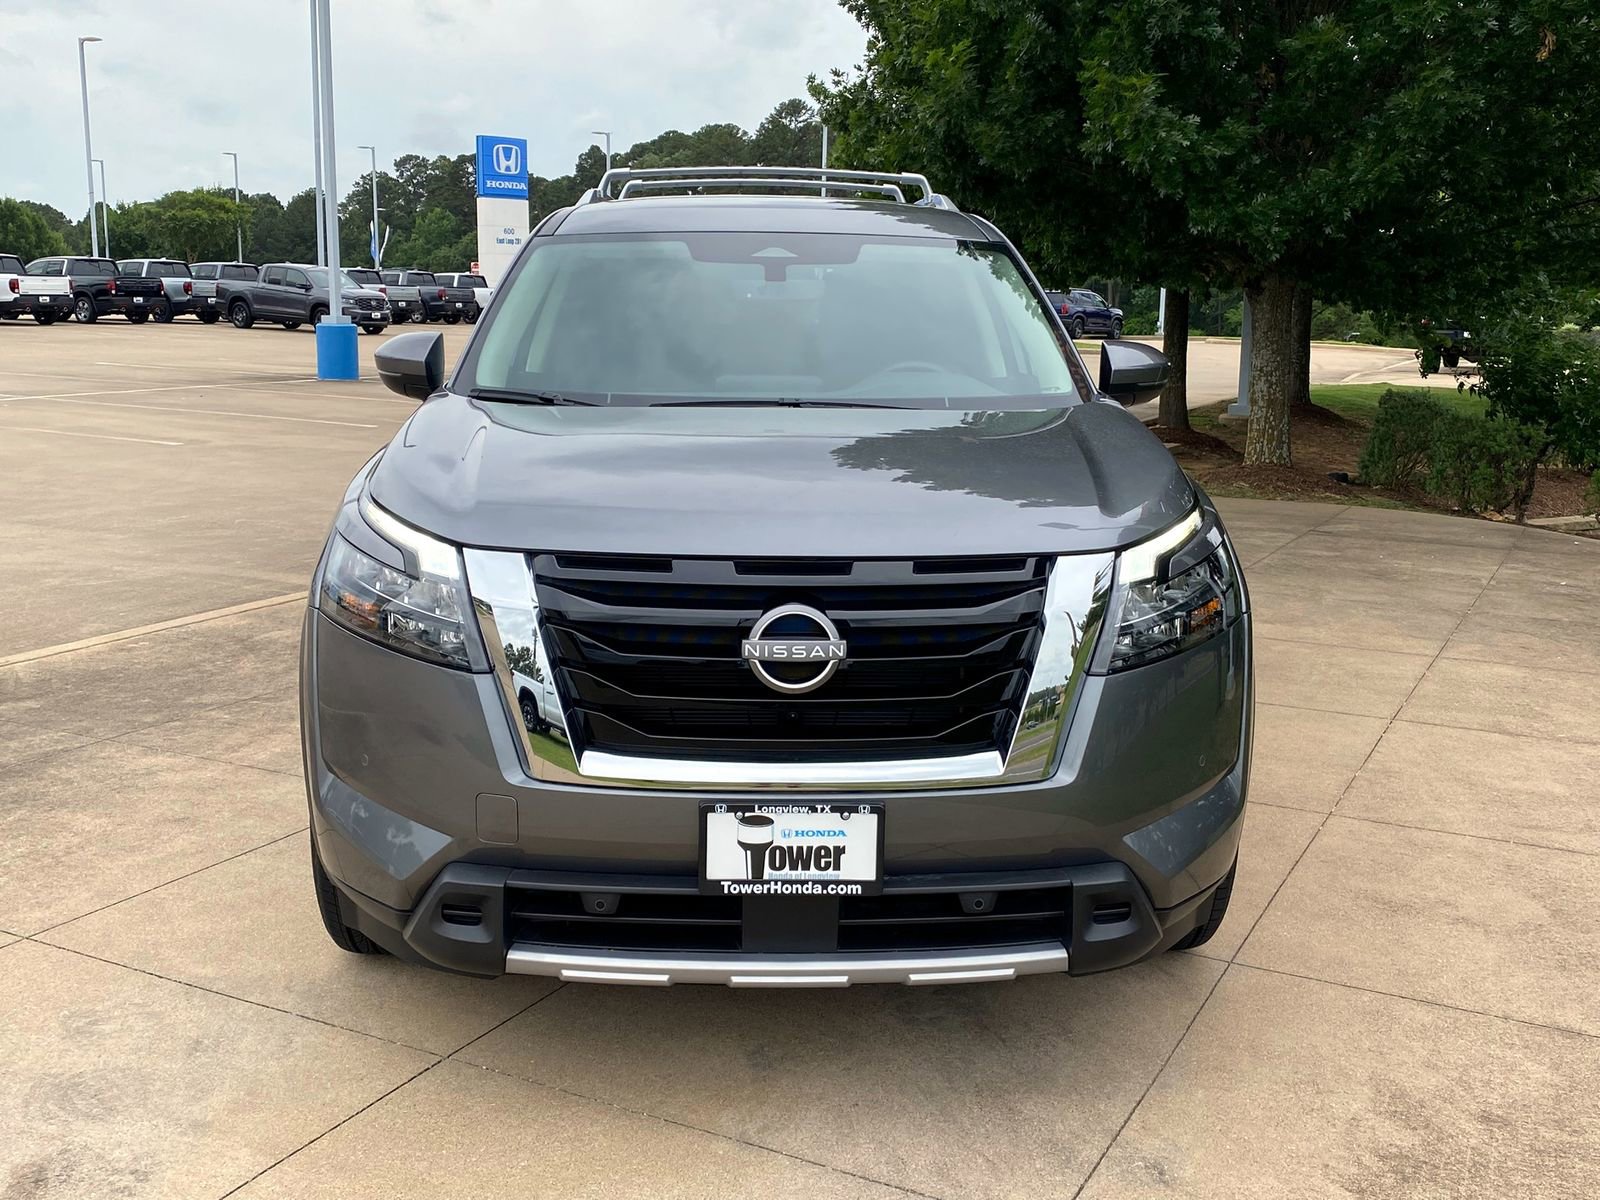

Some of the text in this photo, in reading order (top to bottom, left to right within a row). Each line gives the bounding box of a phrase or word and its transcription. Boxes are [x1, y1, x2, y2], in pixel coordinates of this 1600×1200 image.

[486, 180, 527, 190] HONDA
[744, 643, 844, 658] NISSAN
[754, 804, 832, 815] Longview, TX
[793, 829, 847, 838] HONDA
[768, 871, 841, 880] Honda of Longview
[720, 881, 862, 895] TowerHonda.com
